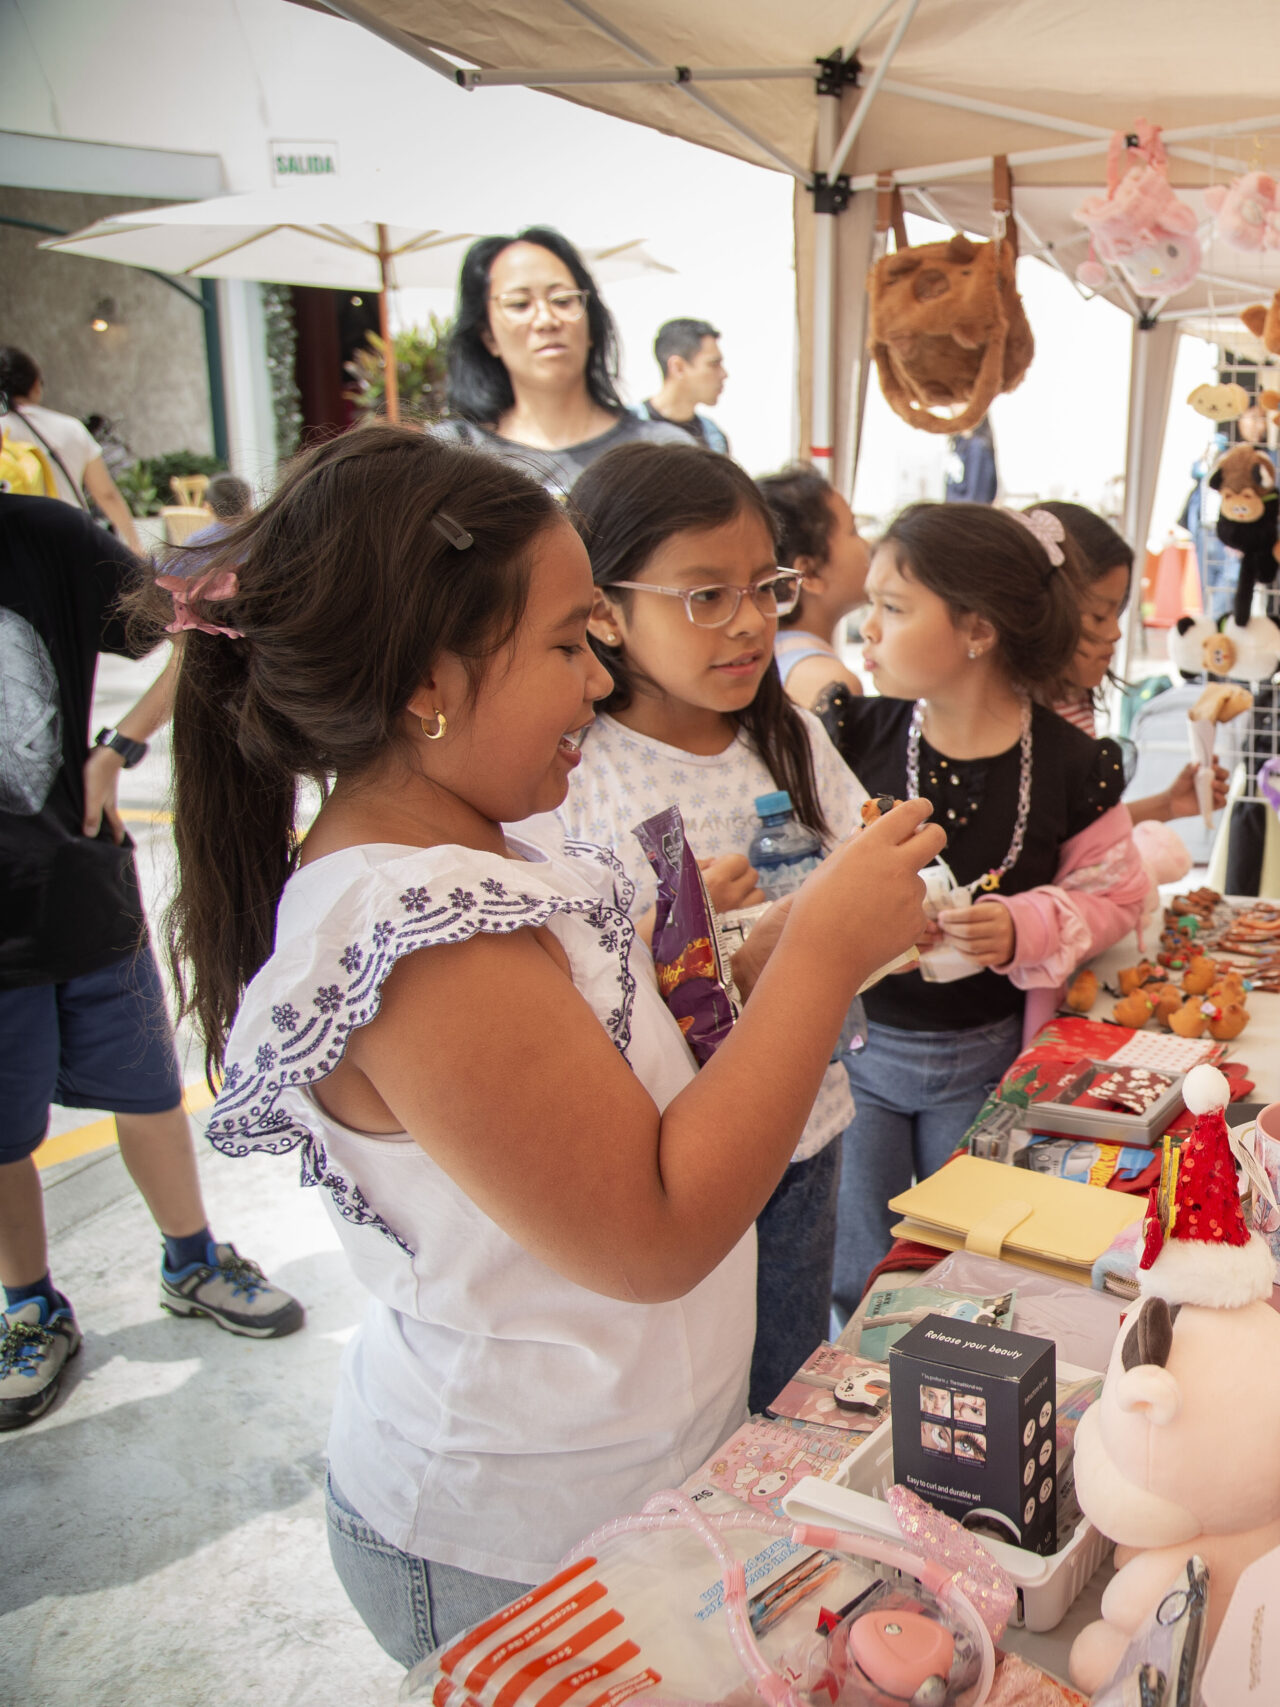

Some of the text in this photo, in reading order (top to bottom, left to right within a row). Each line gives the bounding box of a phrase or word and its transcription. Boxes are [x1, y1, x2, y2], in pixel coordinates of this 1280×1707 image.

[276, 155, 335, 175] SALIDA
[662, 964, 686, 984] Hot
[924, 1330, 1023, 1360] Release your beauty
[690, 1489, 715, 1503] Siz
[905, 1474, 919, 1486] Easy
[925, 1481, 937, 1490] curl
[937, 1484, 949, 1493] and
[948, 1487, 972, 1499] durable
[971, 1493, 981, 1501] set
[541, 1601, 580, 1627] Vacuum
[522, 1625, 542, 1642] out
[506, 1636, 524, 1652] the
[544, 1644, 573, 1667] Seal
